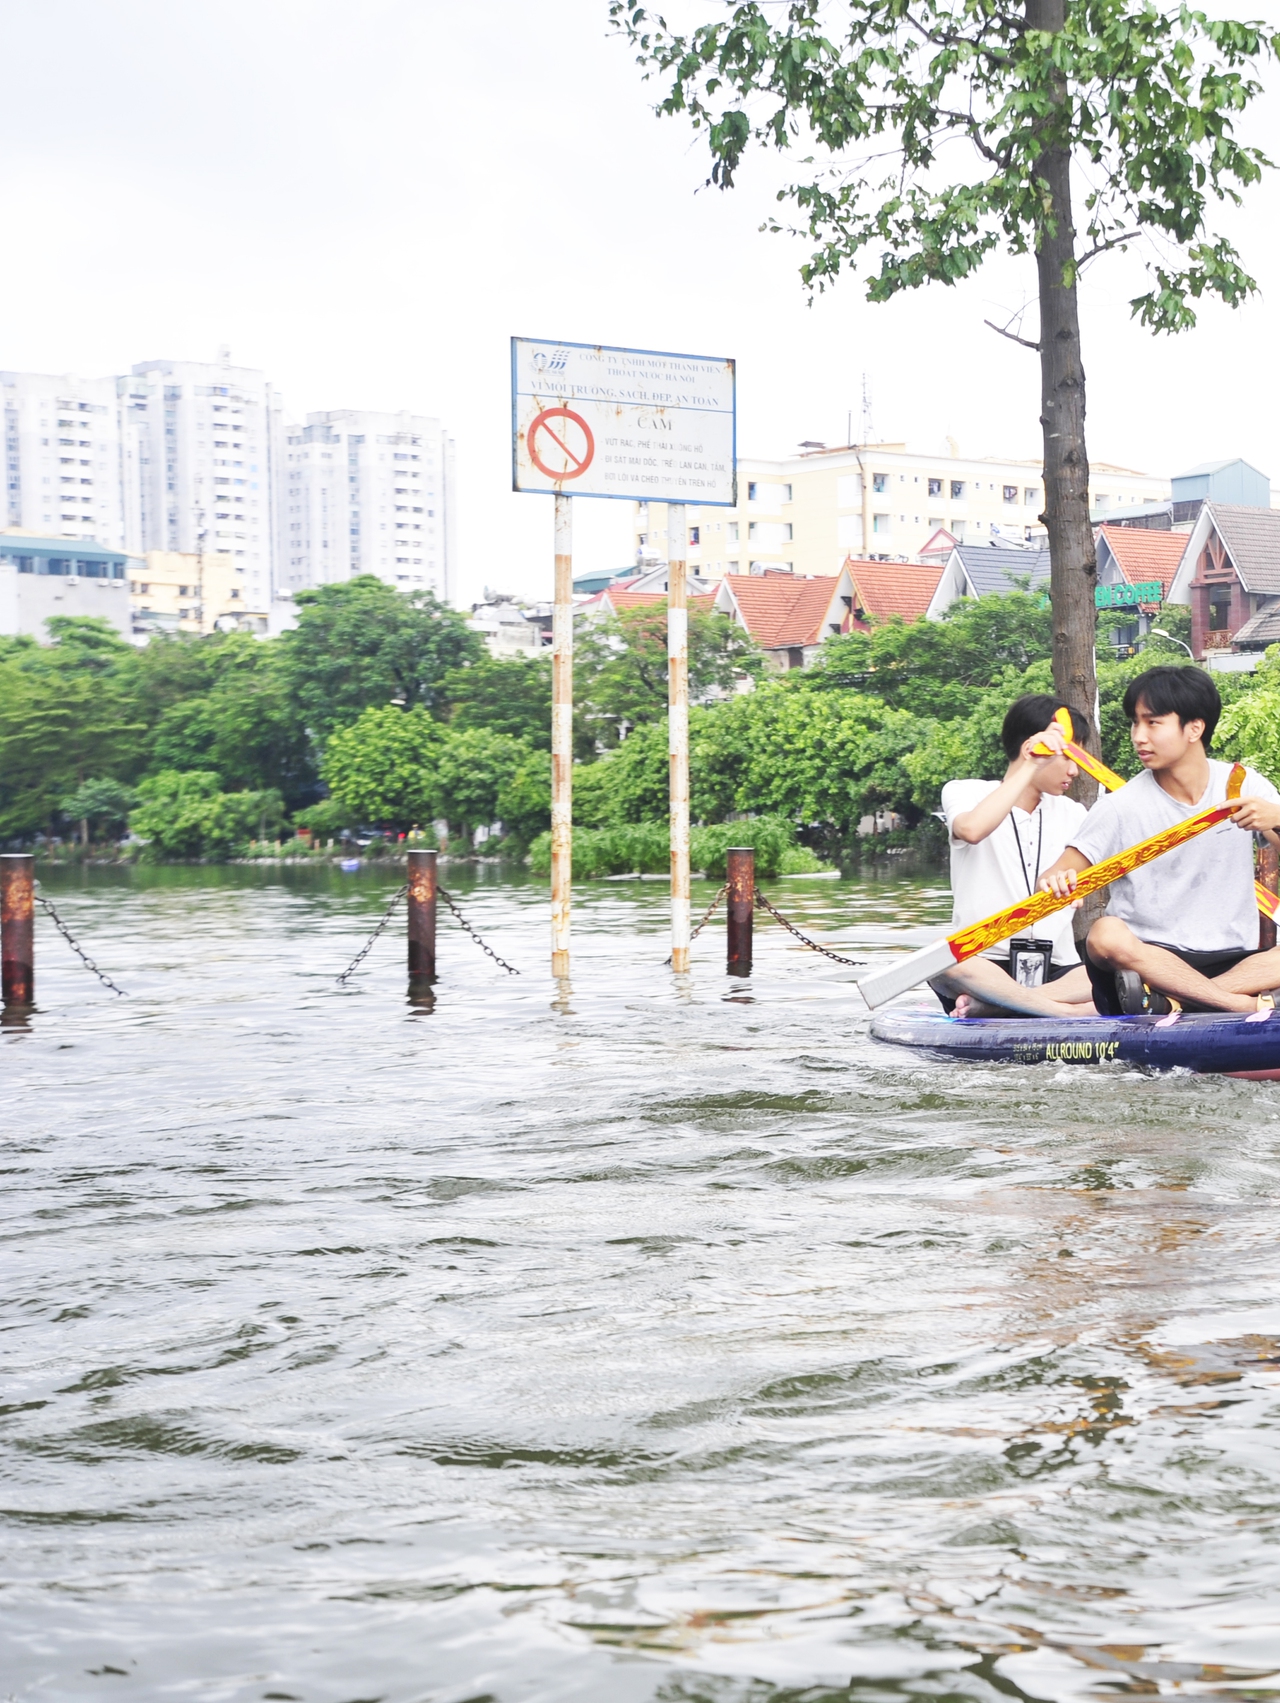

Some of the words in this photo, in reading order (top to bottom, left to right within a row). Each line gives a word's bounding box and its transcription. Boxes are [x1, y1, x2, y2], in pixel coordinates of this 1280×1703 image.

[675, 394, 688, 403] AN
[679, 461, 692, 469] LAN
[1114, 580, 1162, 605] COFFEE
[1046, 1042, 1092, 1060] ALLROUND
